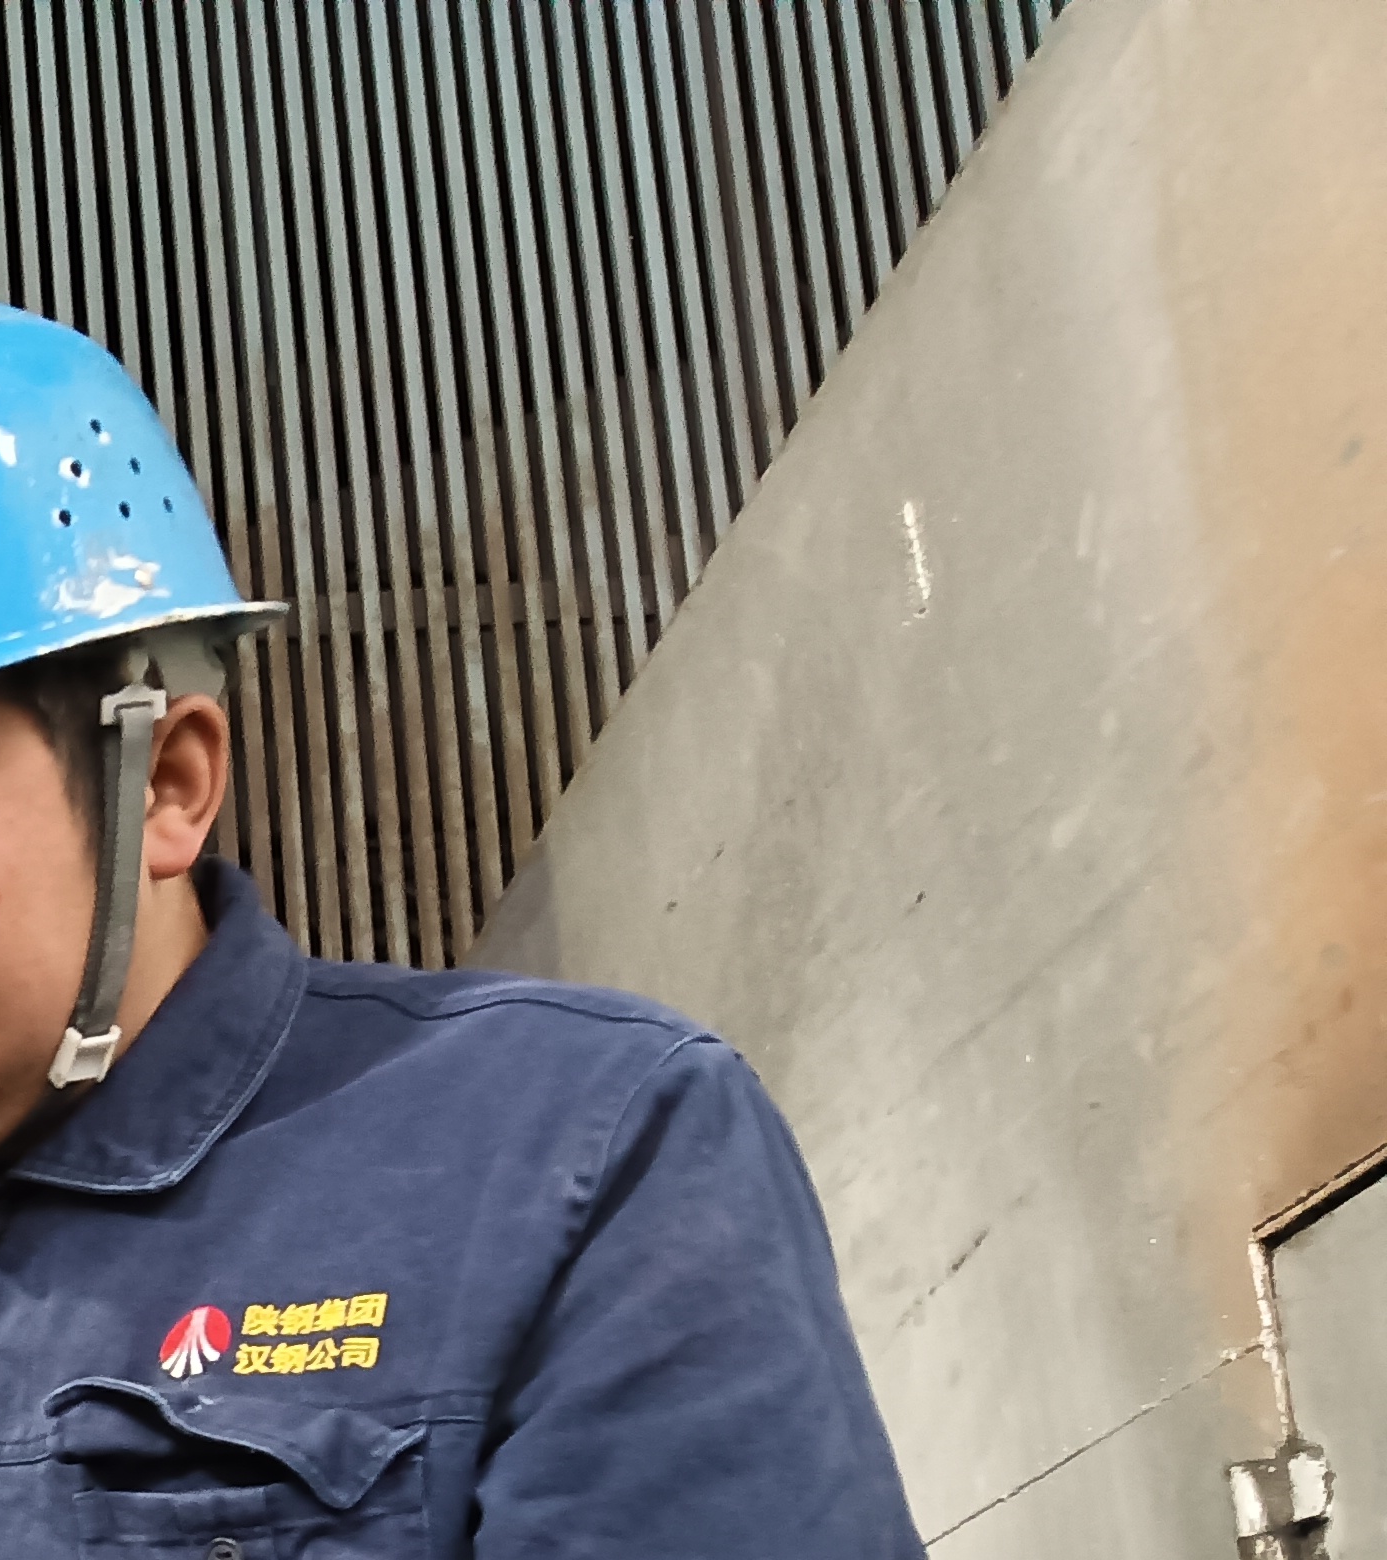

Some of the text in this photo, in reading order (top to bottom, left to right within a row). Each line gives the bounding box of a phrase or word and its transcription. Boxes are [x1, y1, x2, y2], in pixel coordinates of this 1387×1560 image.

[241, 1293, 388, 1335] 陕钢集团
[233, 1337, 380, 1374] 汉钢公司
